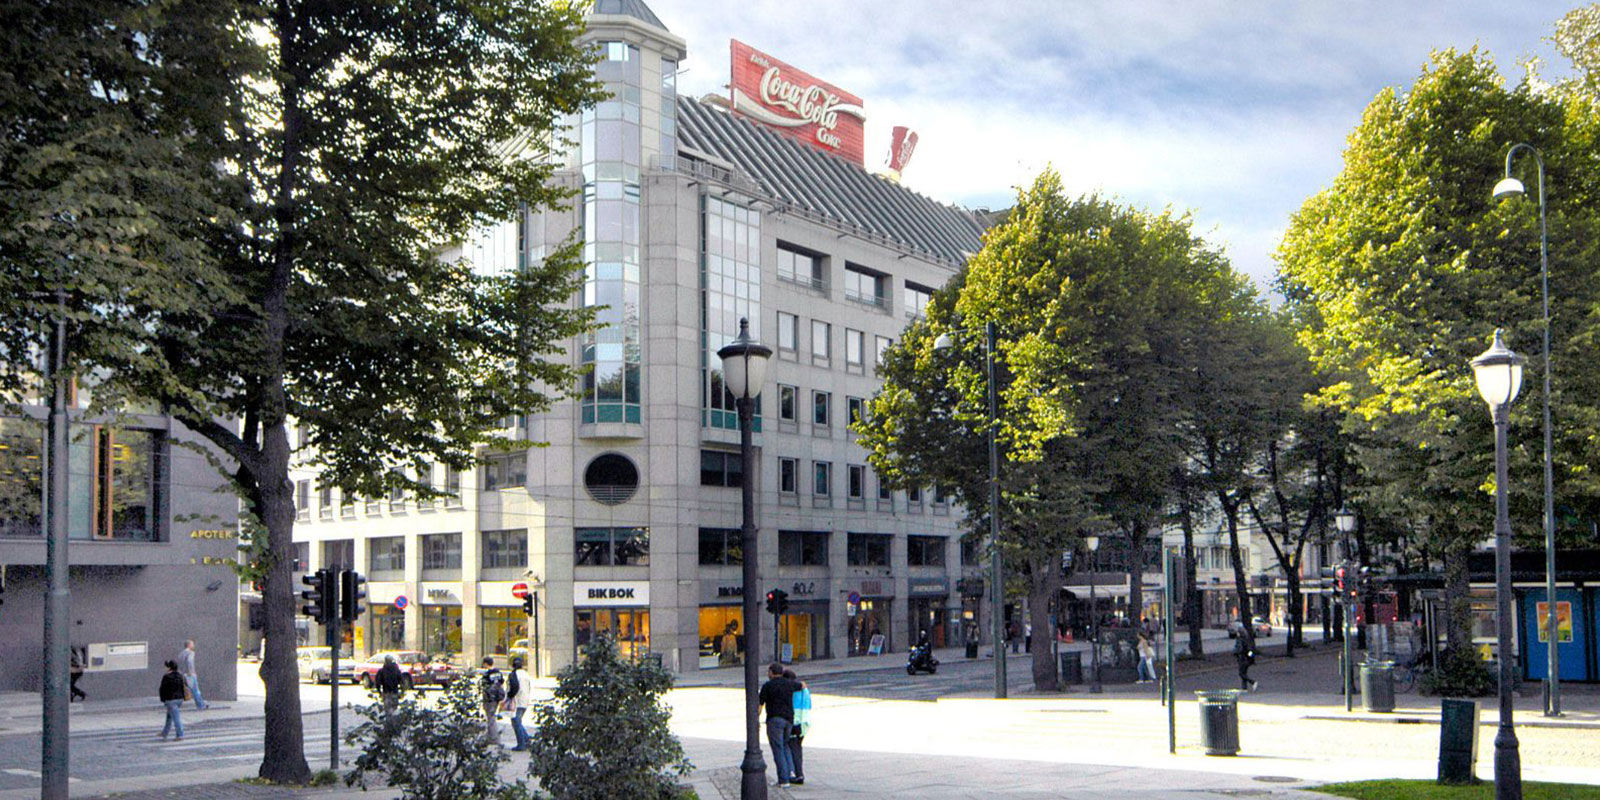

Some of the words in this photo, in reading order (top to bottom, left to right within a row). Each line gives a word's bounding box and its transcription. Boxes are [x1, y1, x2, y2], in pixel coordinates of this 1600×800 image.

[190, 529, 233, 539] APOTEK
[588, 588, 607, 599] BIK
[608, 588, 634, 599] BOK
